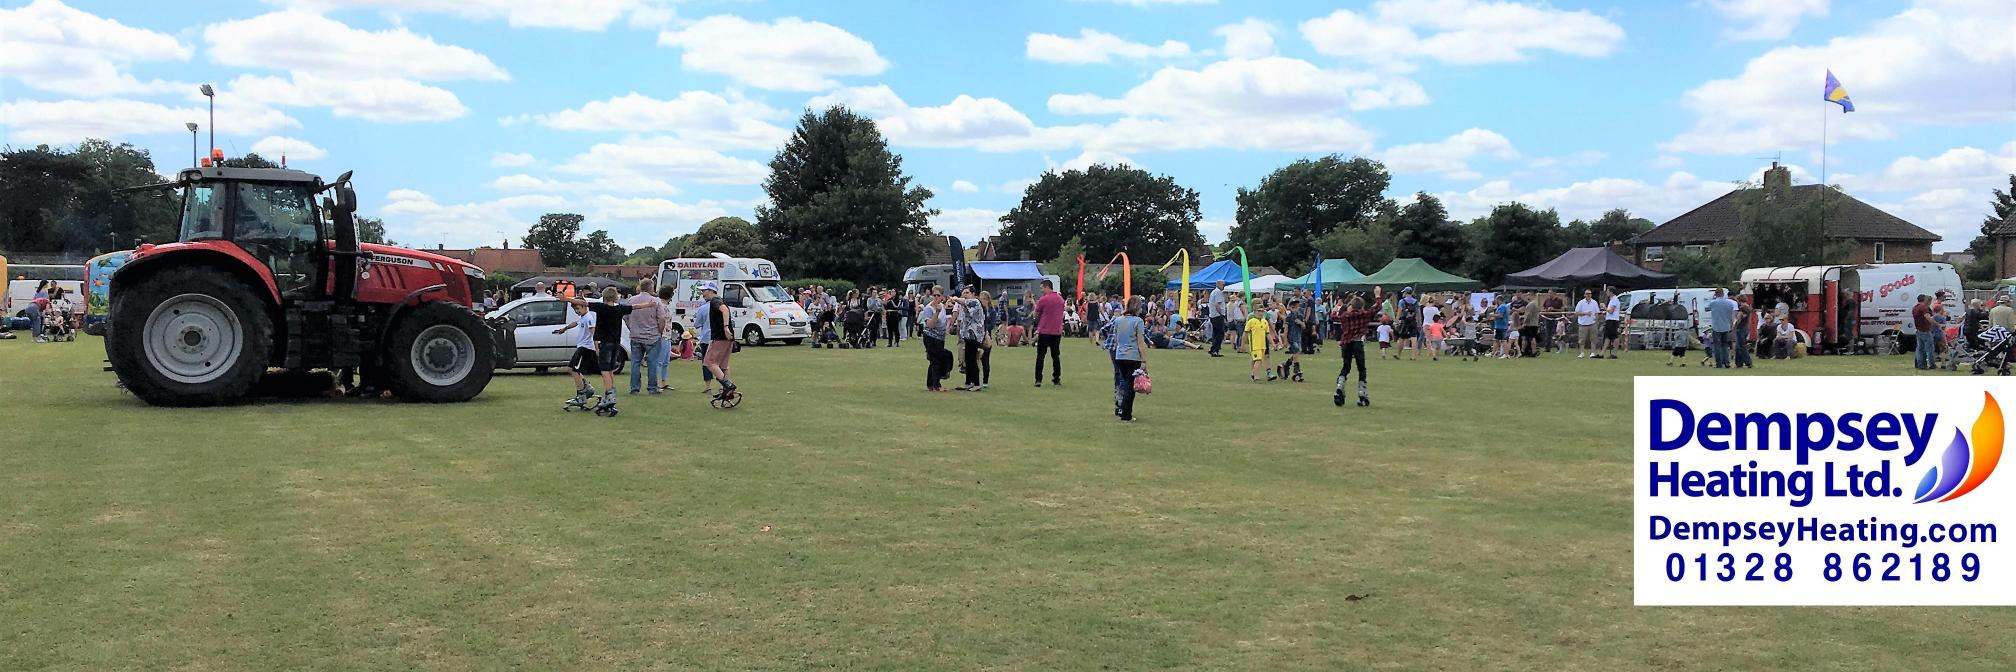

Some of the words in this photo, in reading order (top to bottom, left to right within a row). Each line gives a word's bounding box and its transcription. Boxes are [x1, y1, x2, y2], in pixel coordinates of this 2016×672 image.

[371, 255, 414, 265] FERGUSON
[677, 261, 725, 269] DAIRYLANE
[1879, 274, 1916, 298] goods
